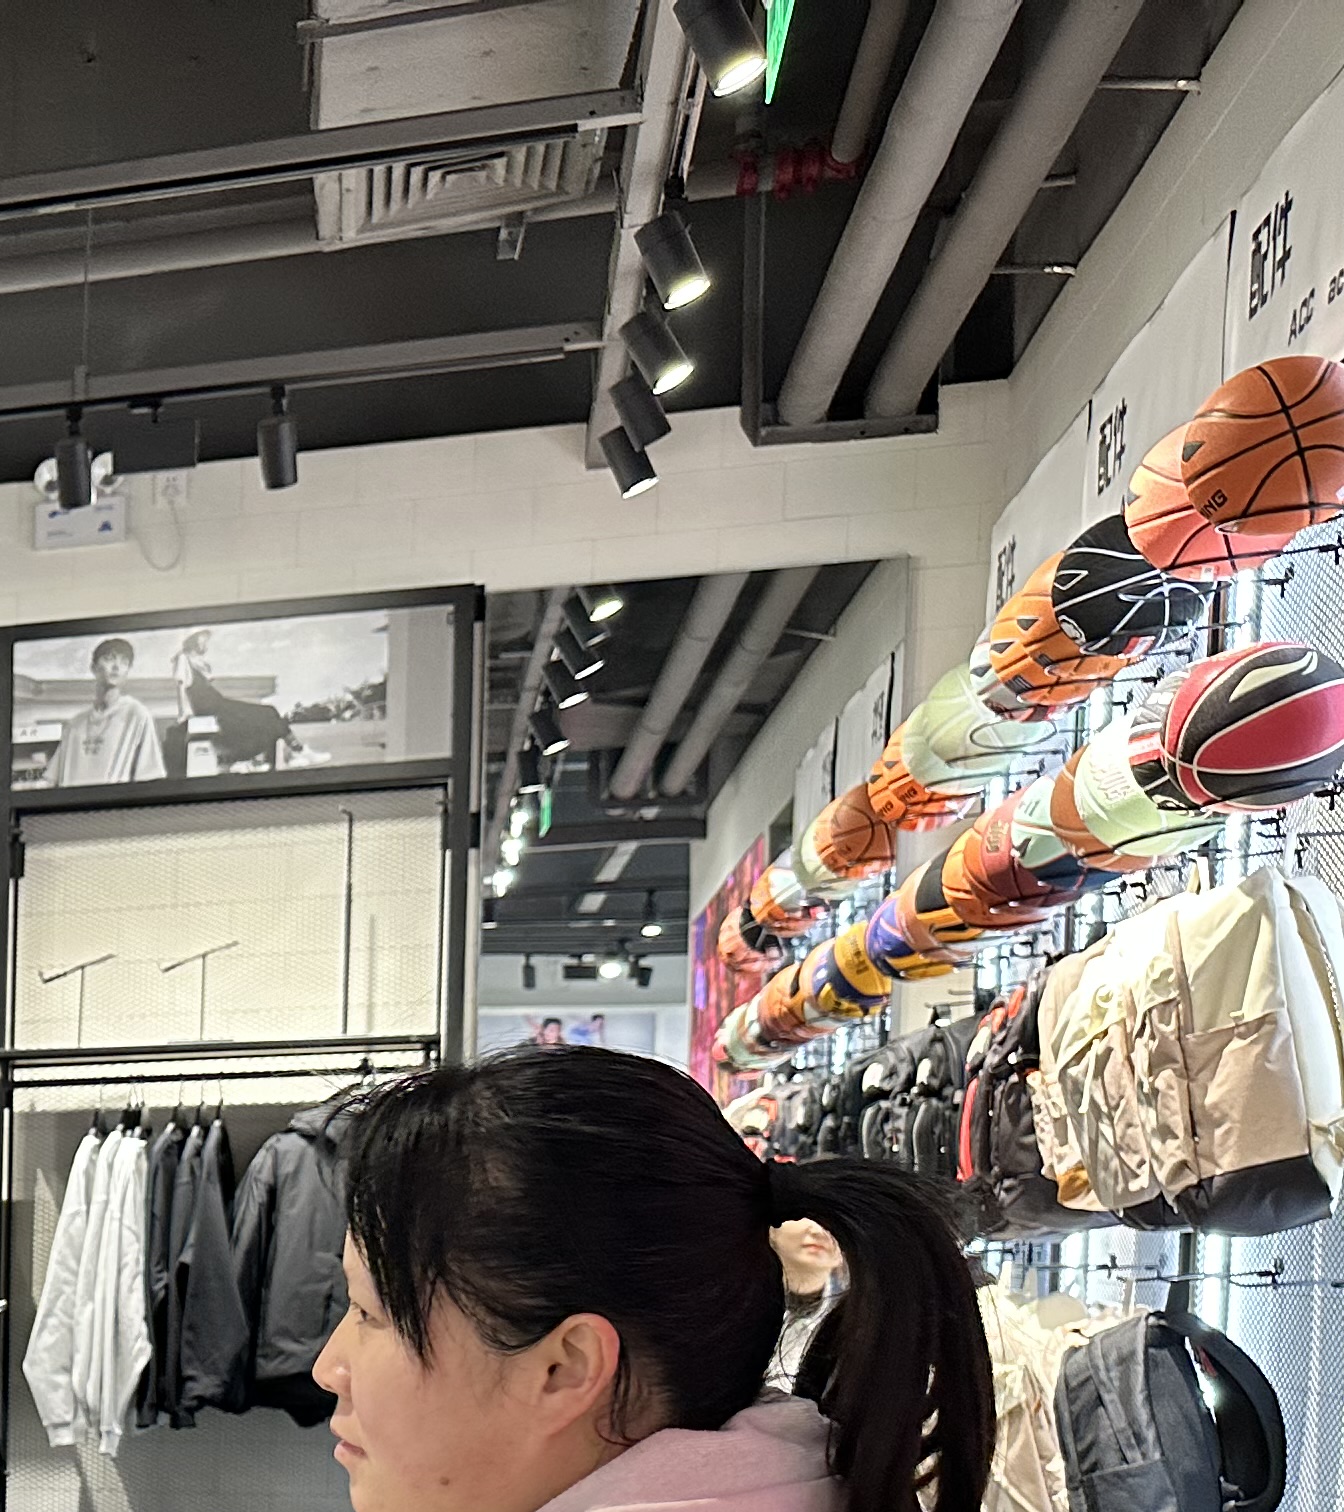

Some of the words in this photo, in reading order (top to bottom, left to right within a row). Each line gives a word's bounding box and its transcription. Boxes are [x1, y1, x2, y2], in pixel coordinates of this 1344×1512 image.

[1249, 190, 1293, 321] 配件
[1288, 287, 1315, 347] ACC
[1097, 397, 1127, 497] 配件
